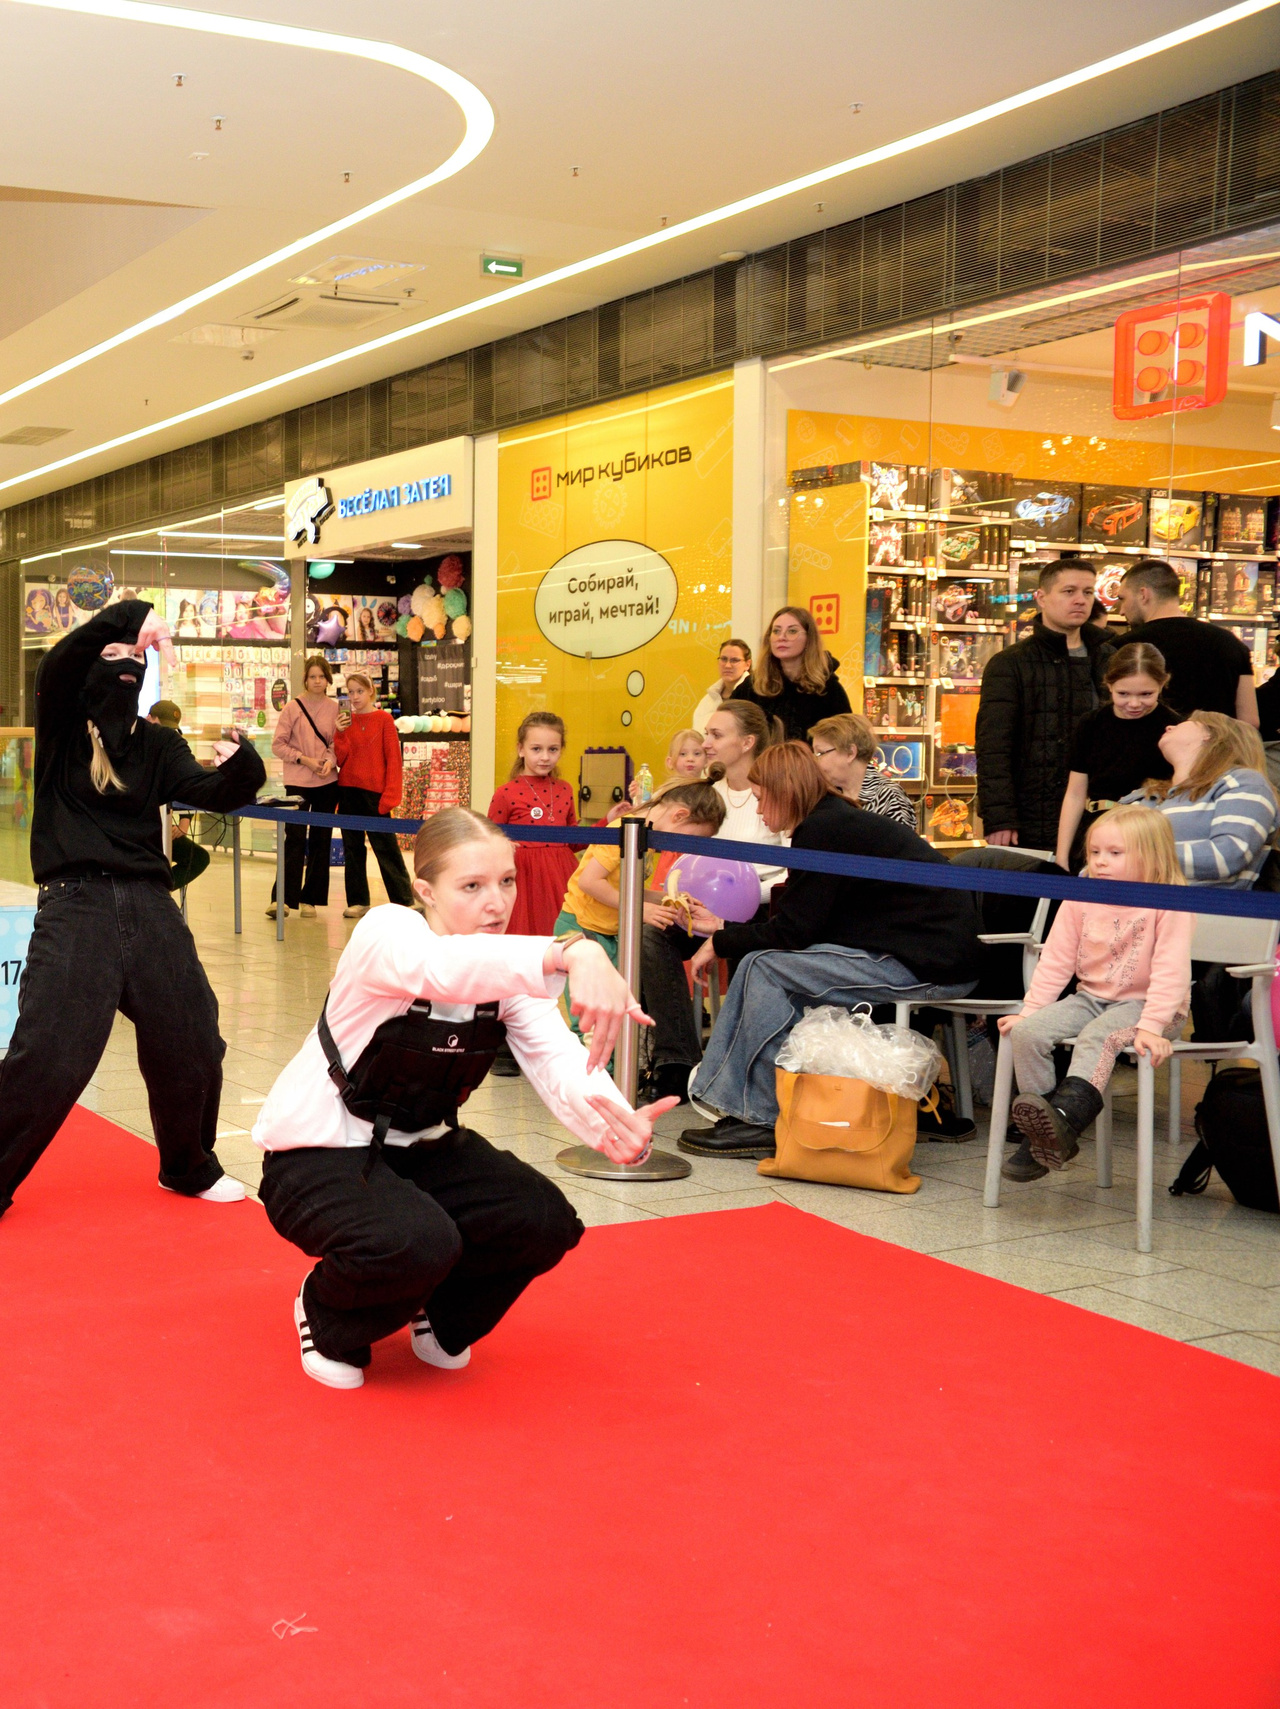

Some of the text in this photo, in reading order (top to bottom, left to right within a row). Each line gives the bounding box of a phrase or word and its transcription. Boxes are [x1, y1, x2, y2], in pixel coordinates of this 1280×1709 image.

[598, 445, 692, 482] кубиков
[337, 487, 401, 519] ВЕСЁЛАЯ
[401, 474, 452, 506] ЗАТЕЯ
[567, 567, 639, 596] Собирай,
[549, 595, 660, 626] играй, мечтай!
[1, 960, 22, 986] 17
